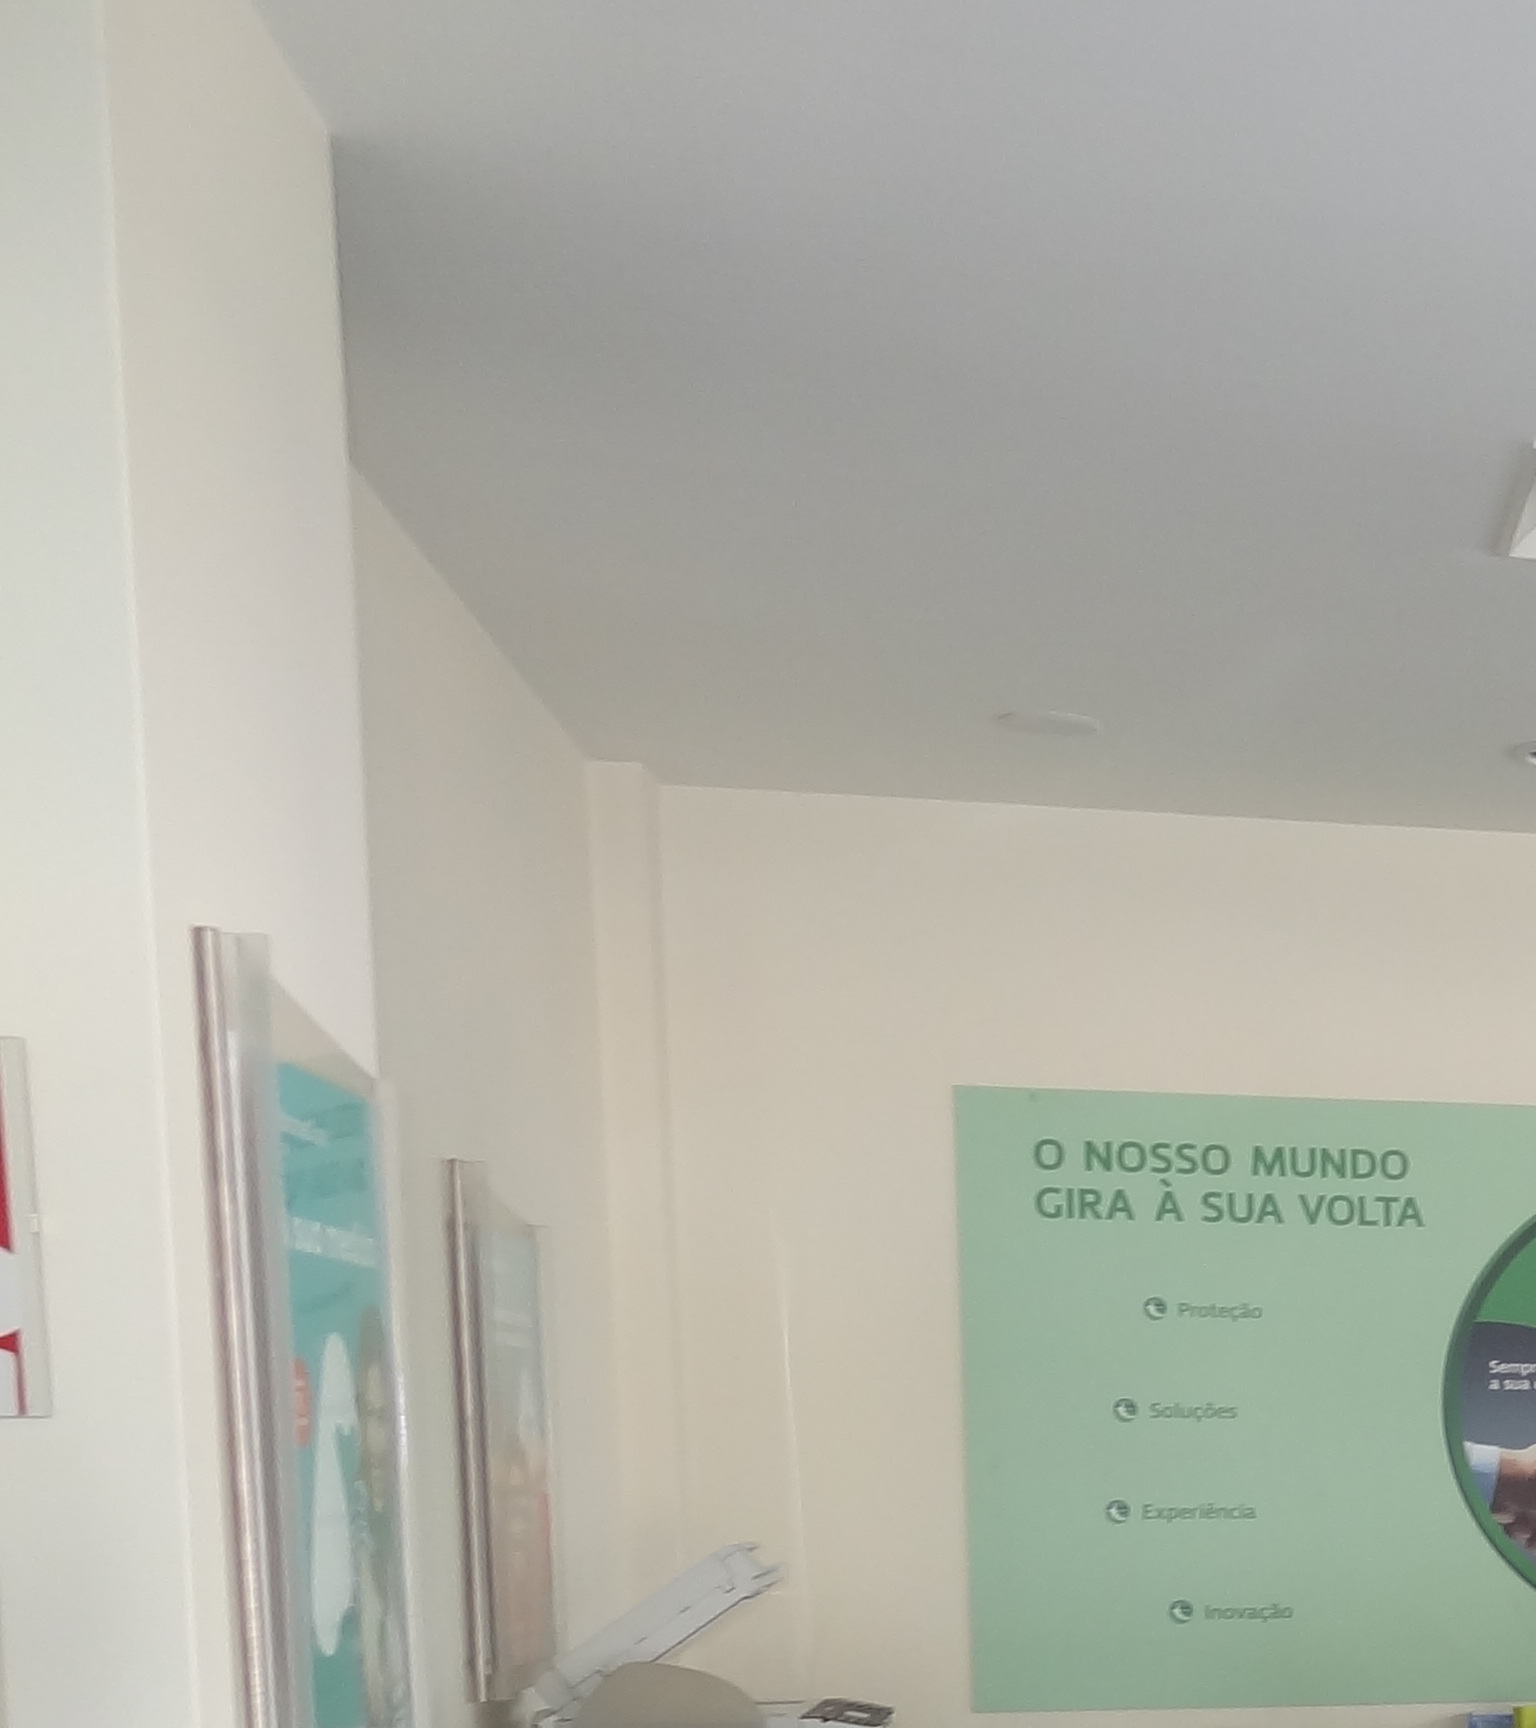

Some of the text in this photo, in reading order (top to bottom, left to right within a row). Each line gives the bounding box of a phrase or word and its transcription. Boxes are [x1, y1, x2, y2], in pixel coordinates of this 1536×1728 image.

[1033, 1138, 1410, 1181] O NOSSO MUNDO
[1034, 1178, 1426, 1228] GIRA À SUA VOLTA
[1177, 1302, 1264, 1323] Proteção
[1488, 1379, 1500, 1390] a
[1503, 1379, 1531, 1391] sua
[1149, 1401, 1238, 1422] Soluções
[1141, 1502, 1257, 1522] Experiência
[1203, 1602, 1294, 1624] Inovação
